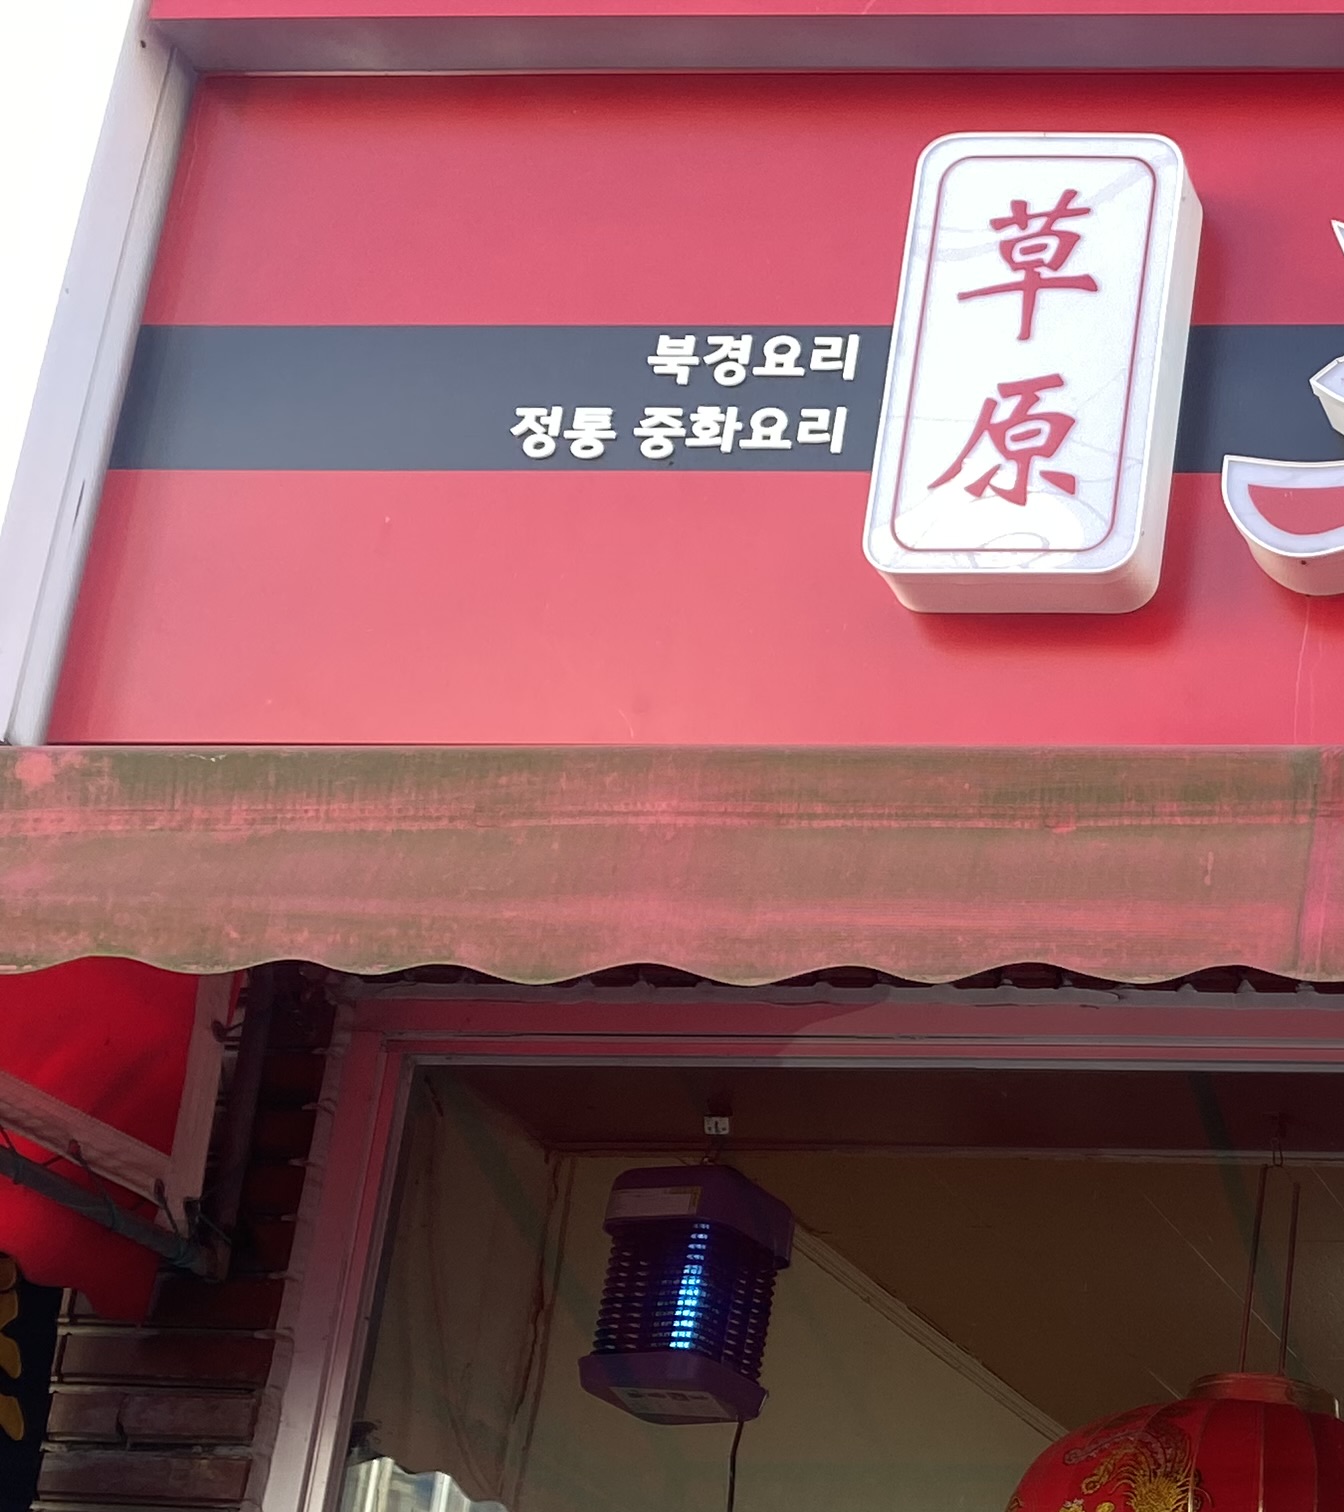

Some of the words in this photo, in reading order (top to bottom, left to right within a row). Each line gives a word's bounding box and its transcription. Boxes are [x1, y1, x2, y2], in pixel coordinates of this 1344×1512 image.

[647, 334, 860, 387] 북경요리
[929, 189, 1098, 507] 草原
[510, 406, 617, 461] 정통
[633, 406, 848, 461] 중화요리
